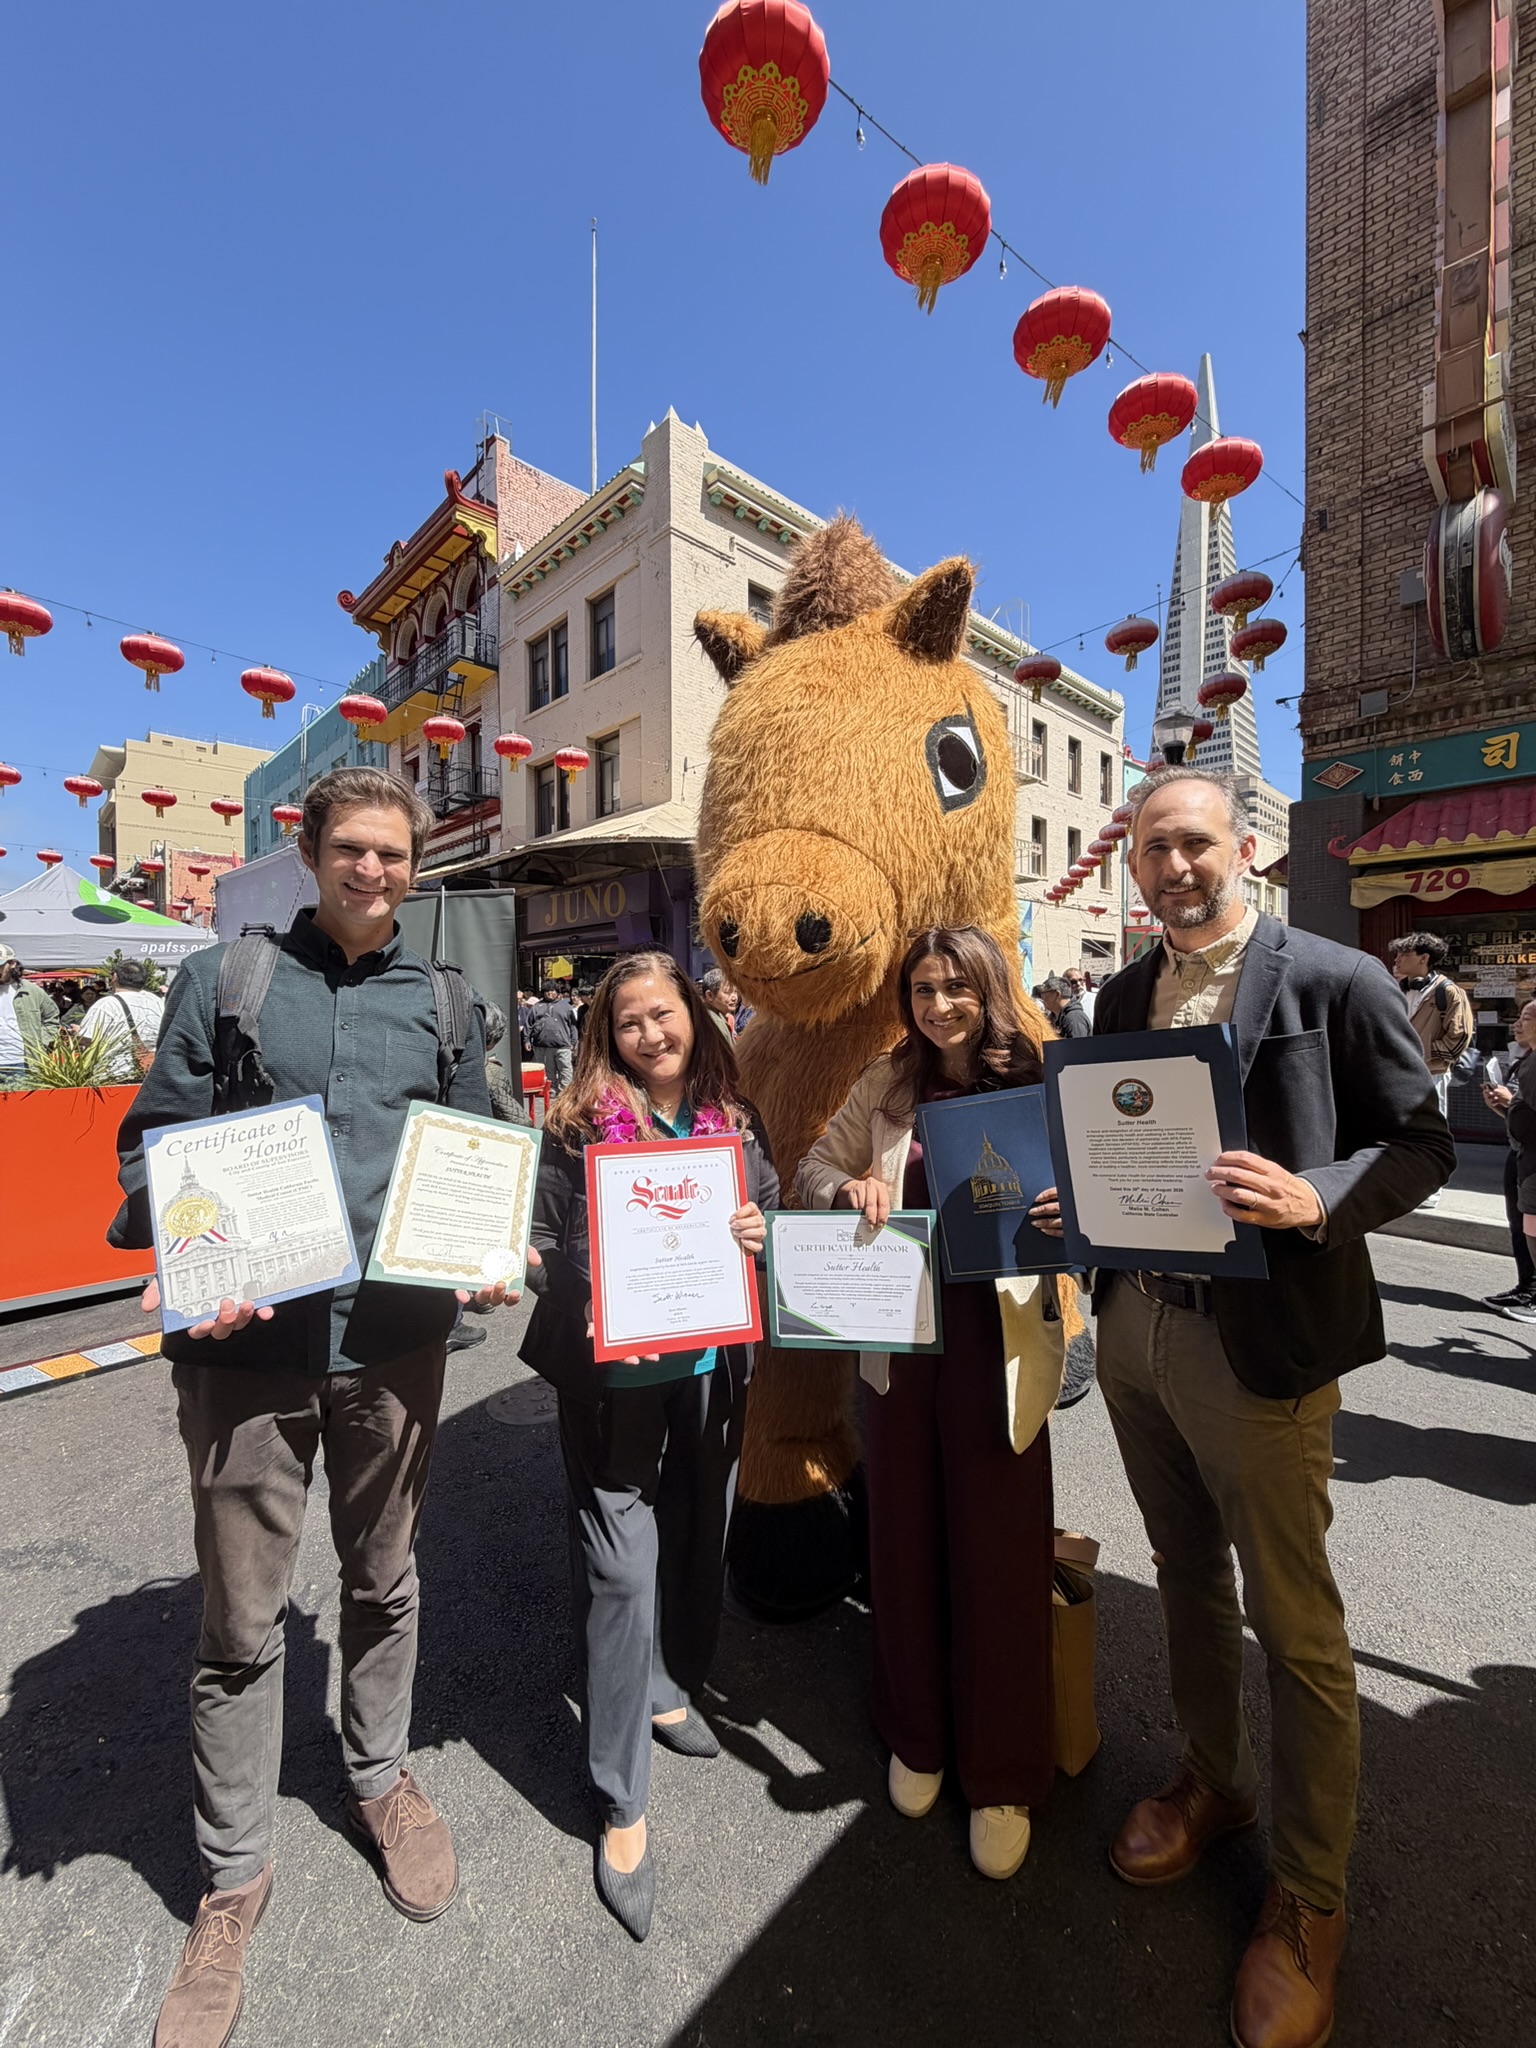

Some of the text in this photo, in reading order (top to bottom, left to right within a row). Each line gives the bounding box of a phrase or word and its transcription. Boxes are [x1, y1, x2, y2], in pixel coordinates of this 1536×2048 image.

[1481, 731, 1520, 769] 司
[1404, 867, 1469, 894] 720
[544, 881, 626, 927] JUNO
[166, 1110, 305, 1157] Certificate of
[243, 1136, 308, 1162] Honor
[626, 1174, 712, 1218] Senate
[794, 1244, 910, 1253] CERTIFICATE OF HONOR
[823, 1260, 884, 1272] Sutter Health
